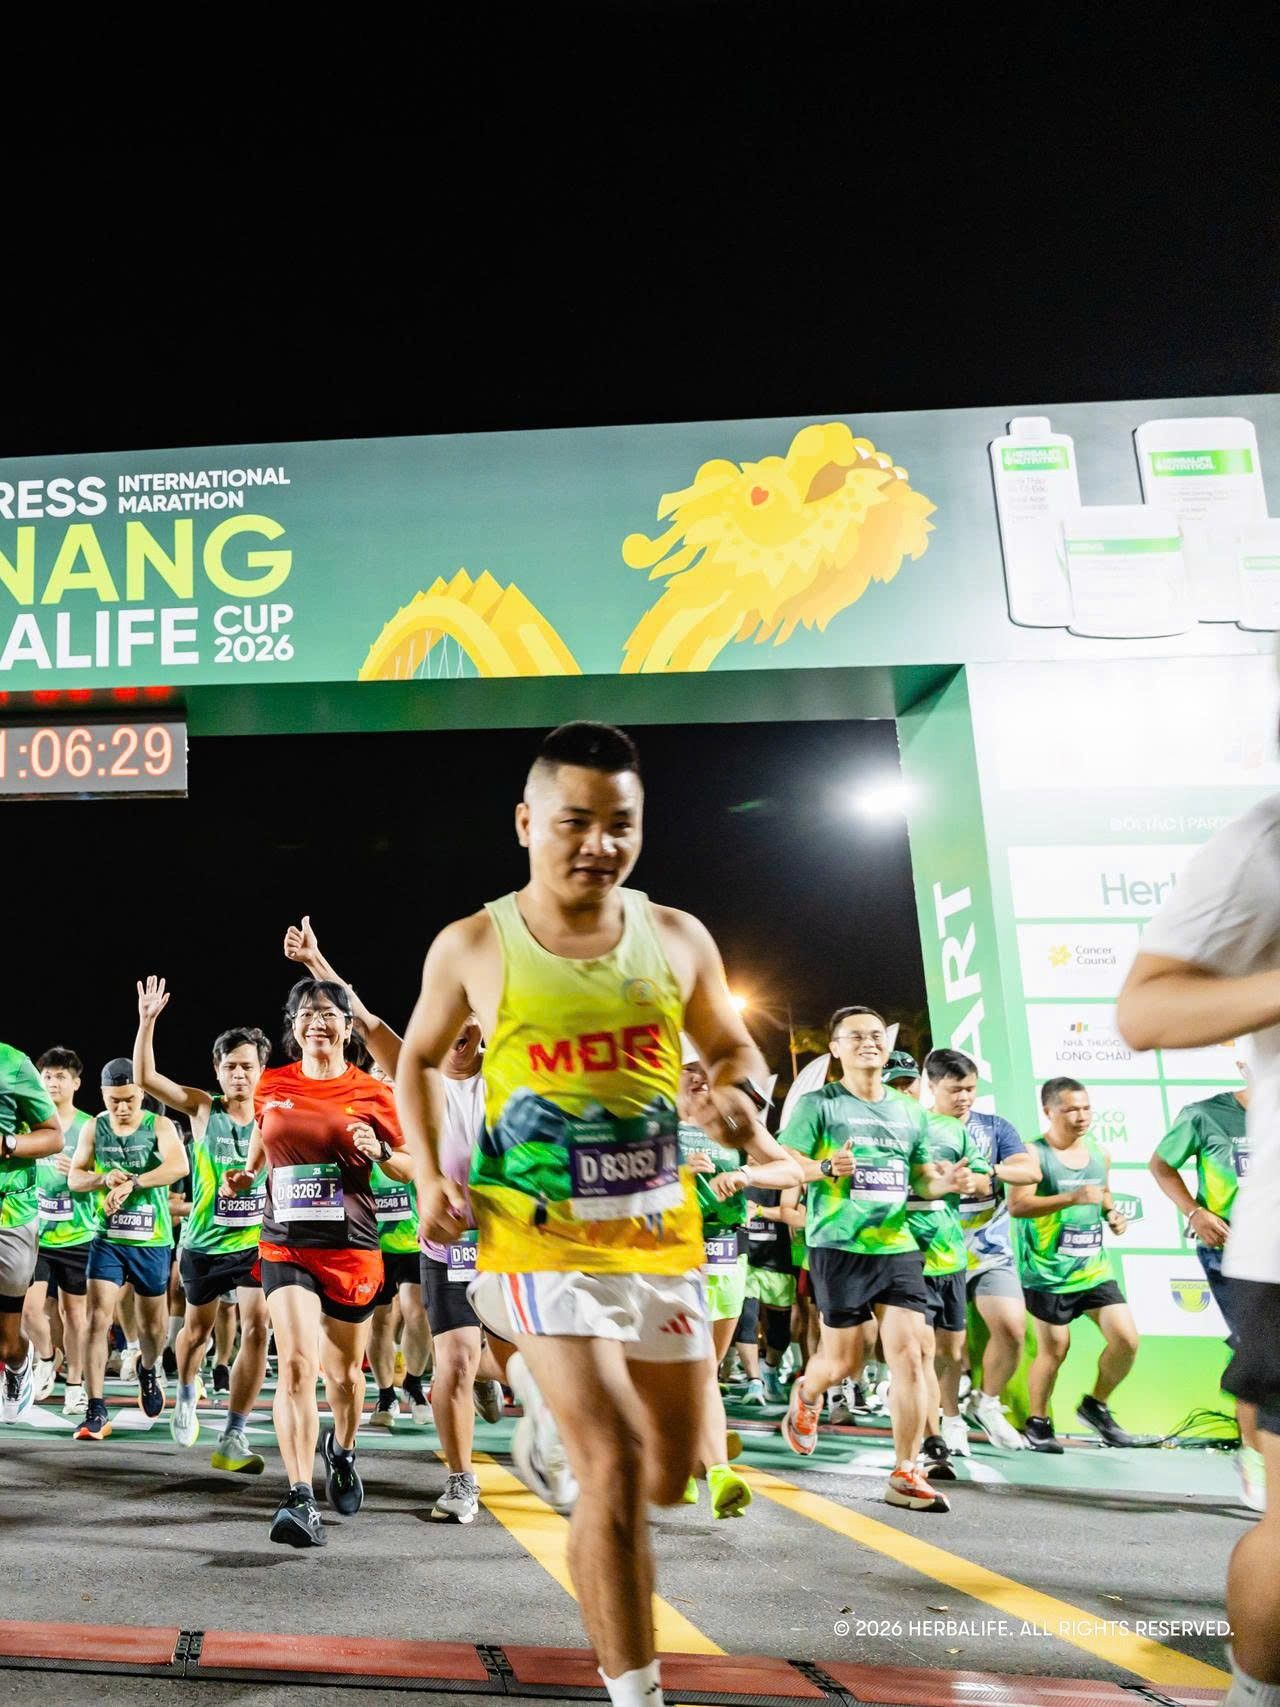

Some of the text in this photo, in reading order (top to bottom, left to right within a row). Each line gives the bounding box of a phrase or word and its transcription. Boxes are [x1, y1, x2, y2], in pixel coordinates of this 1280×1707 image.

[118, 467, 290, 493] INTERNATIONAL
[118, 491, 244, 514] MARATHON
[213, 604, 293, 635] CUP
[213, 635, 294, 664] 2026
[1075, 944, 1113, 955] Cancer
[1076, 955, 1117, 966] Council
[1055, 1051, 1092, 1061] LONG
[330, 1184, 337, 1199] F
[400, 1197, 408, 1207] M
[144, 1214, 153, 1227] M
[728, 1242, 734, 1257] F
